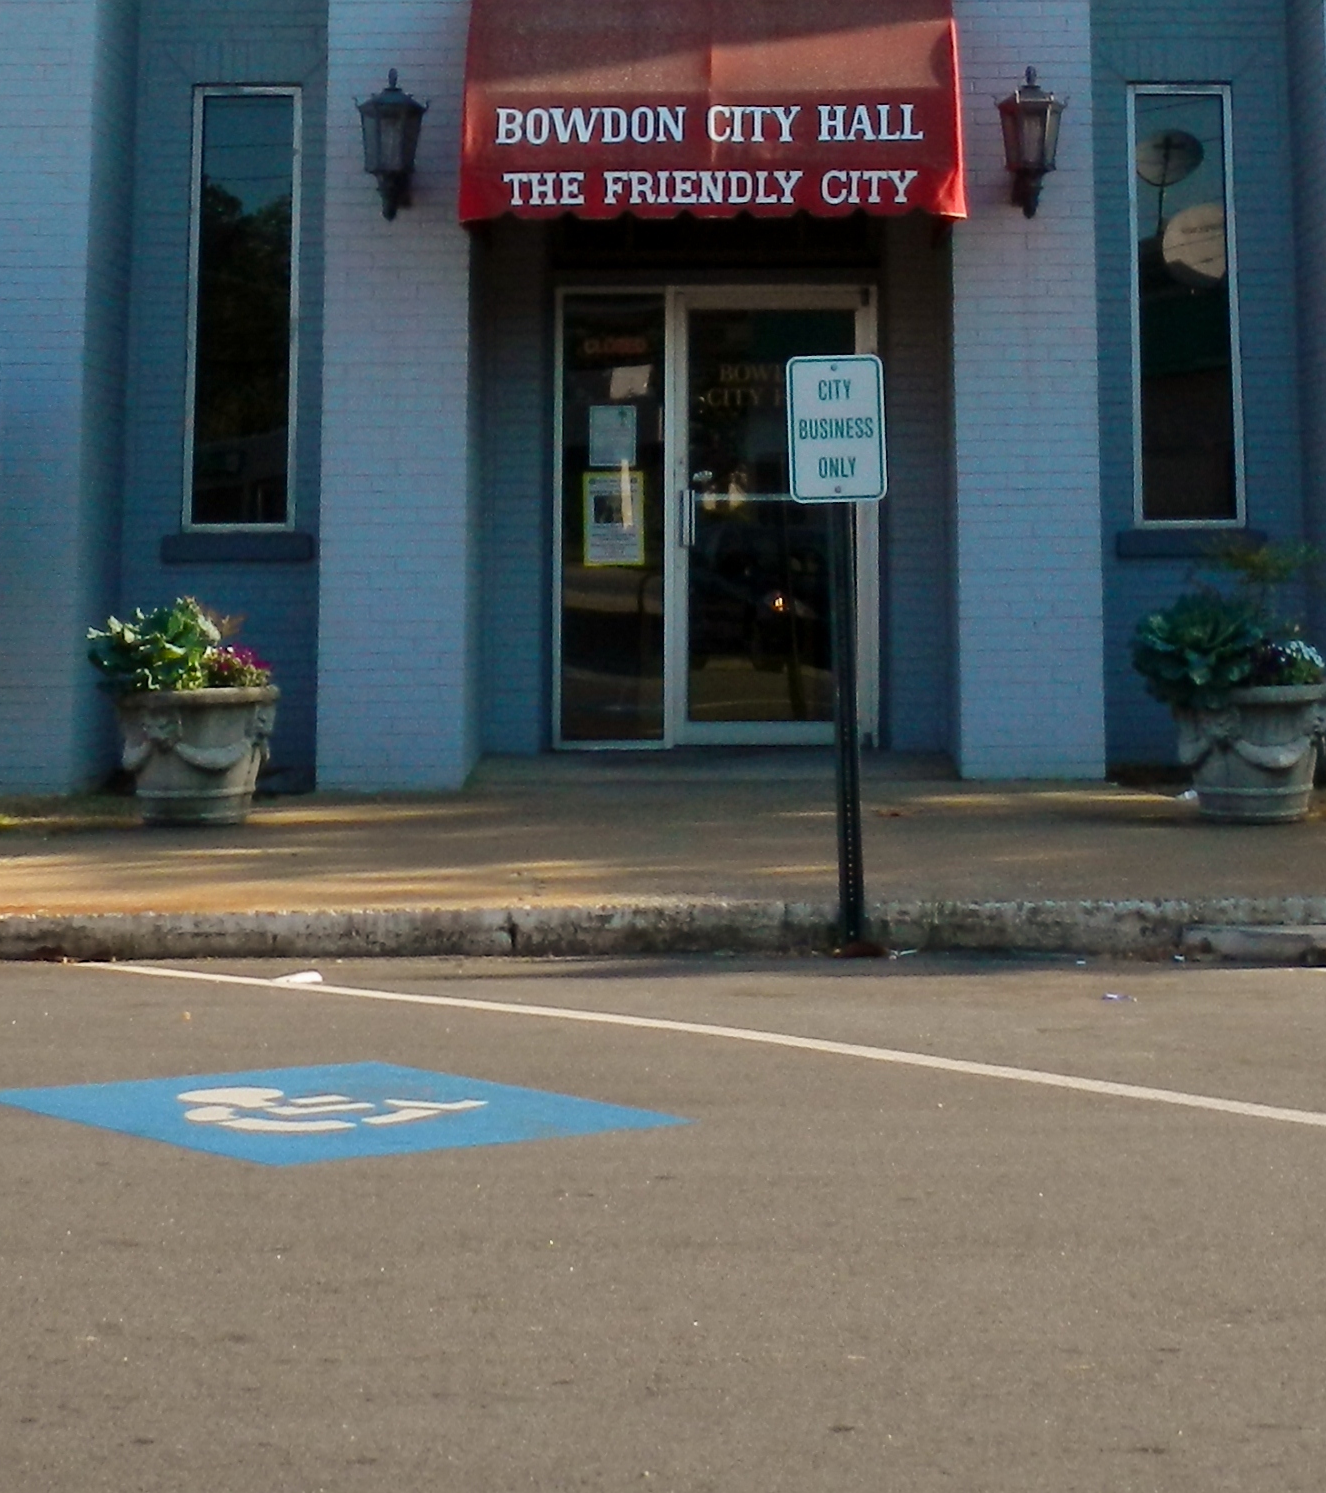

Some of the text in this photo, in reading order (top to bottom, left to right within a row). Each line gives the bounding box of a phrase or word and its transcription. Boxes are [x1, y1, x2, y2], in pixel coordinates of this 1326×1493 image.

[495, 104, 924, 146] BOWDON CITY HALL
[502, 170, 918, 205] THE FRIENDLY CITY
[818, 379, 852, 401] CITY
[799, 417, 874, 440] BUSINESS
[818, 457, 856, 478] ONLY
